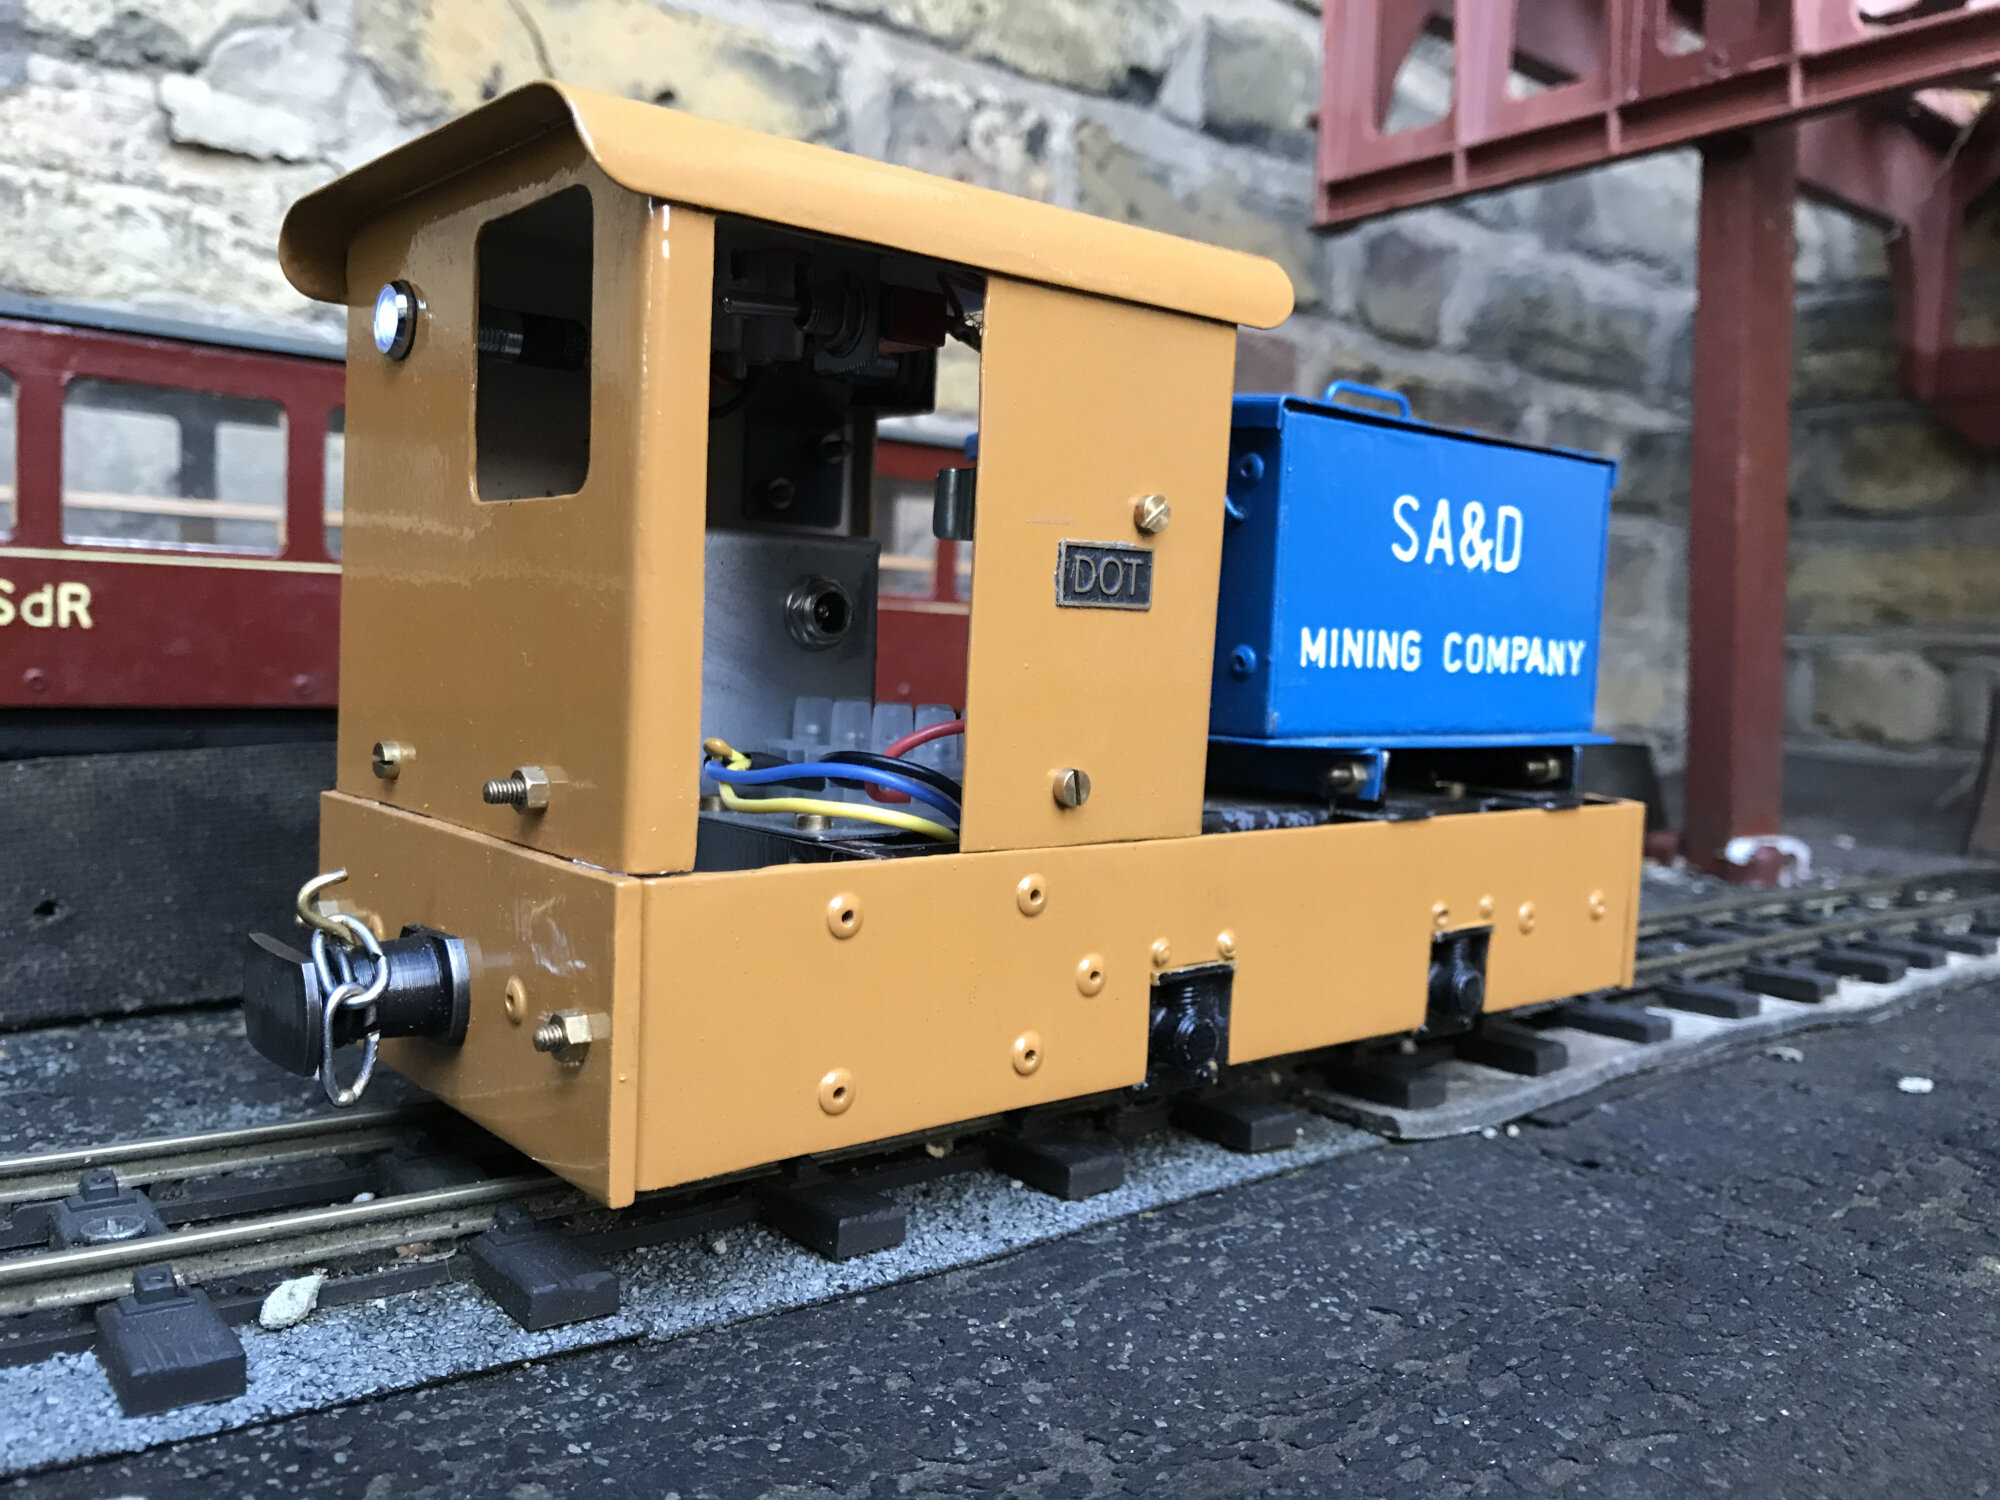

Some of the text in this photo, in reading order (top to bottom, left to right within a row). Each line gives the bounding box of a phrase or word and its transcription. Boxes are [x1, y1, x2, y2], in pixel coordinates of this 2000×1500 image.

[1391, 494, 1524, 574] SA&D
[1074, 554, 1145, 596] DOT
[1299, 626, 1587, 677] MINING COMPANY
